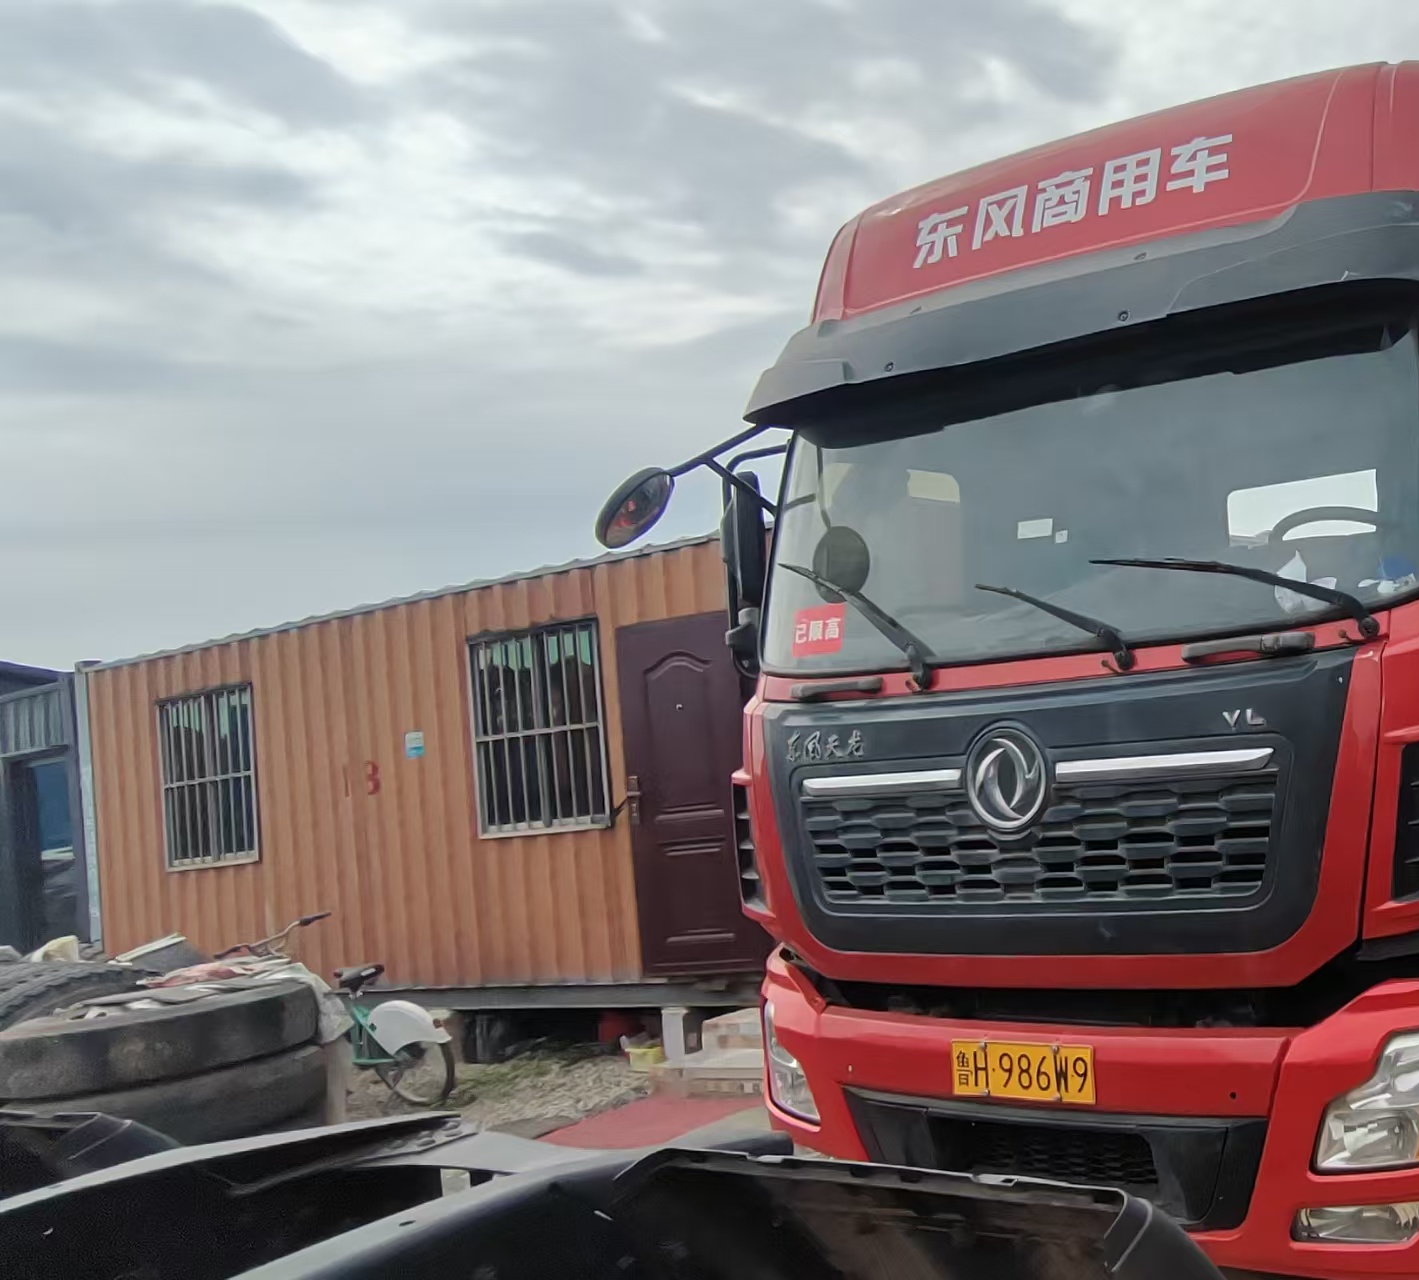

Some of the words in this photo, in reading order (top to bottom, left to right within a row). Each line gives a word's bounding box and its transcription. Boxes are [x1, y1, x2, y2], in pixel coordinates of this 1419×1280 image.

[912, 133, 1233, 269] 东风商用车
[1221, 707, 1266, 728] VL
[786, 729, 864, 762] 东风天龙
